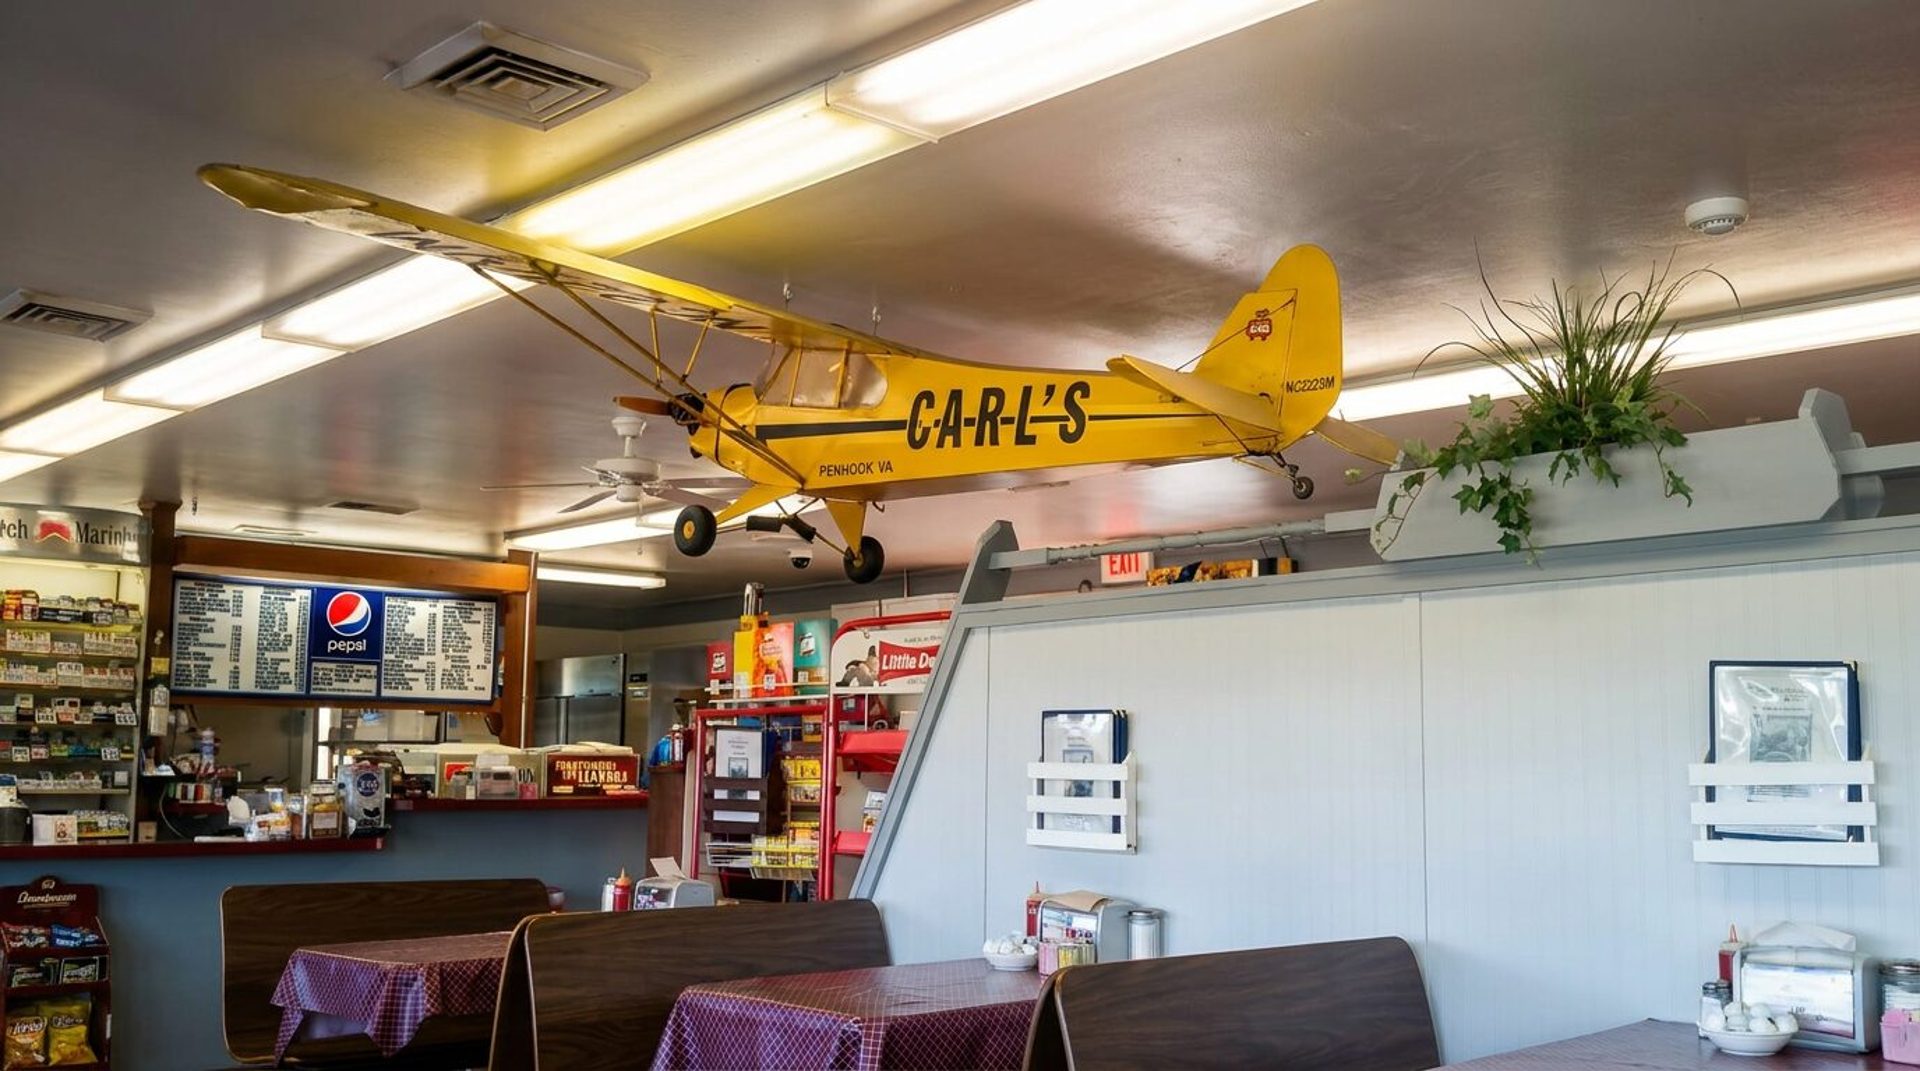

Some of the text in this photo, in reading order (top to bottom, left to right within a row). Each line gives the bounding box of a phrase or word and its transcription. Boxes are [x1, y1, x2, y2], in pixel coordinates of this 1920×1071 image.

[819, 461, 894, 477] PENHOOK VA
[327, 640, 367, 654] pepsi
